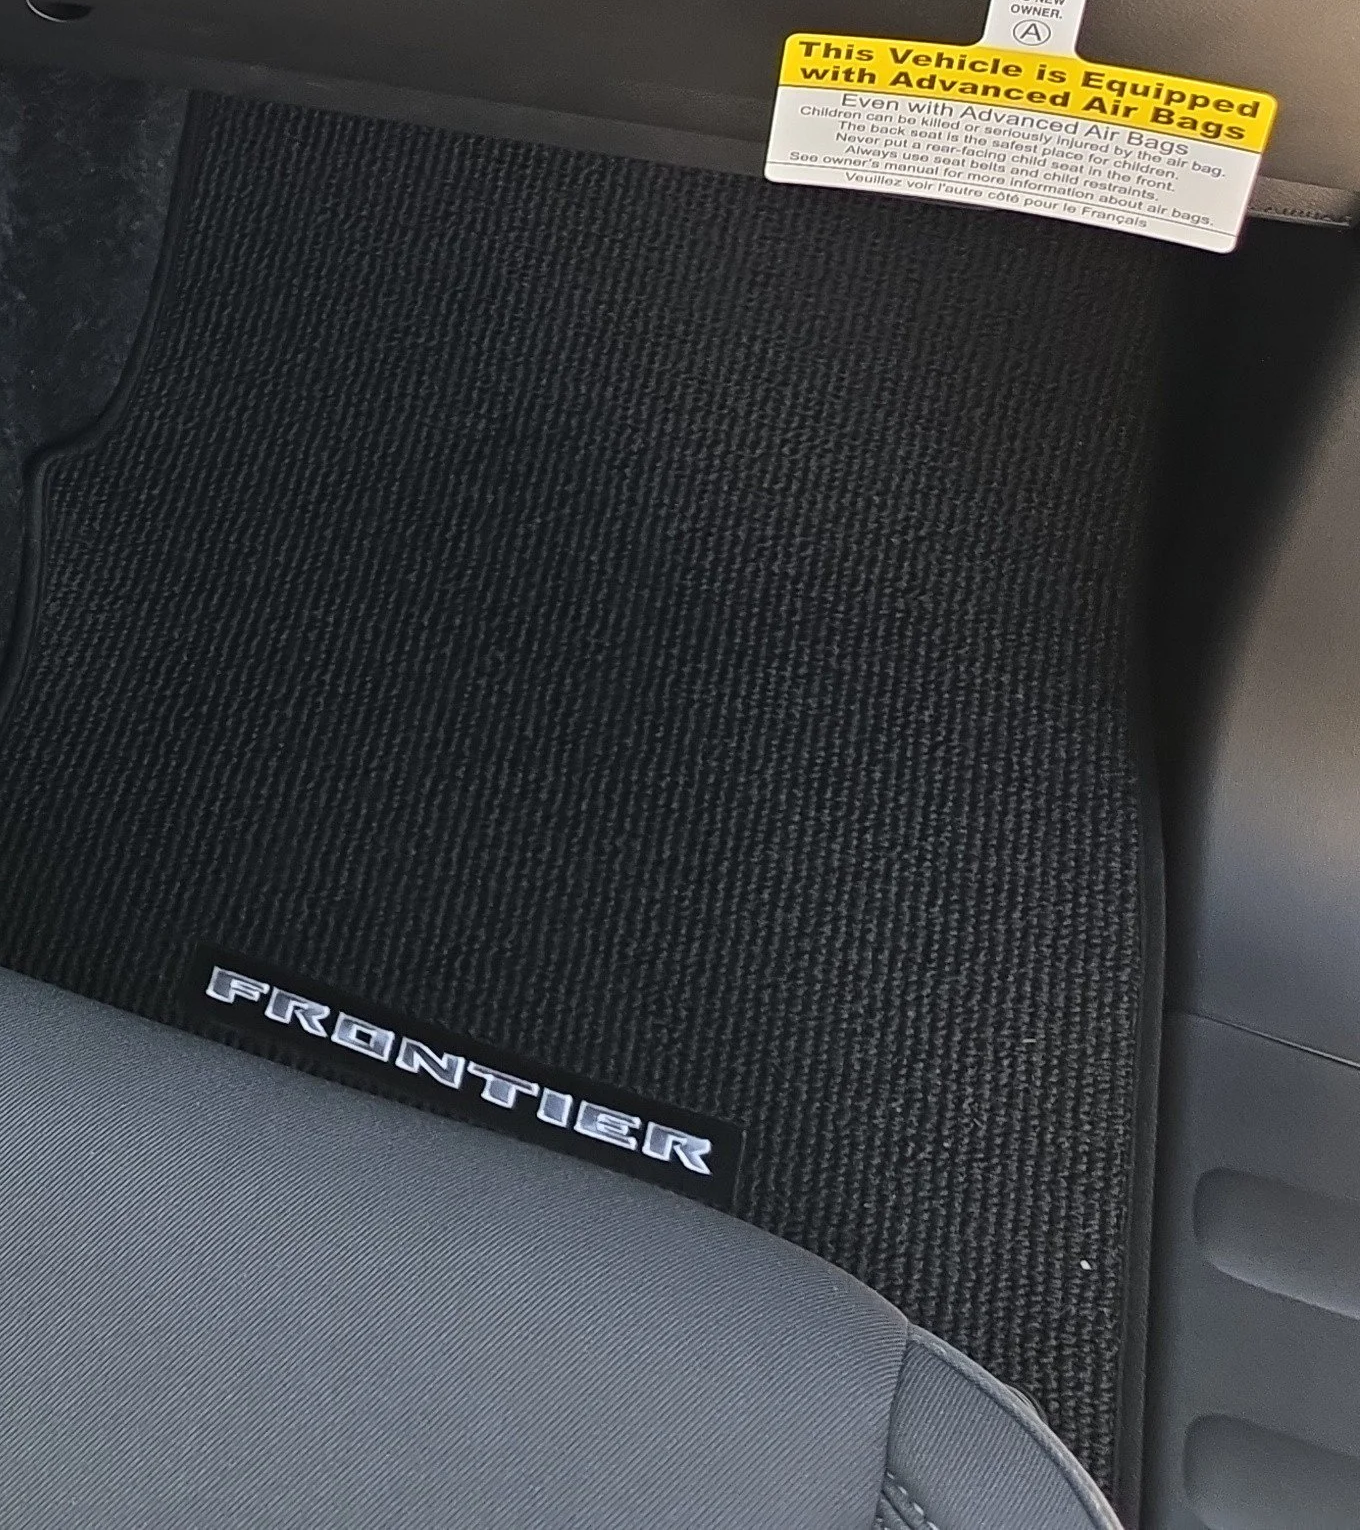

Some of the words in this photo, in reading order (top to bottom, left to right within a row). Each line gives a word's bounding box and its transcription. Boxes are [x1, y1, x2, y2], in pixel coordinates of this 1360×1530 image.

[1010, 3, 1062, 19] OWNER.
[1019, 22, 1041, 41] A
[799, 41, 874, 61] This
[889, 47, 1023, 77] Vehicle
[1036, 64, 1067, 83] is
[1081, 70, 1260, 118] Equipped
[800, 66, 876, 85] with
[889, 71, 1070, 108] Advanced
[1081, 96, 1139, 118] Air
[1150, 106, 1246, 140] Bags
[800, 105, 861, 120] Children
[866, 112, 893, 123] can
[898, 114, 917, 125] be
[921, 116, 961, 131] killed
[964, 123, 980, 133] or
[984, 125, 1052, 145] seriously
[1056, 135, 1111, 155] injured
[1114, 144, 1132, 160] by
[1137, 150, 1162, 164] the
[1167, 154, 1188, 171] air
[1193, 161, 1227, 178] bag.
[838, 120, 865, 132] The
[870, 123, 905, 137] back
[910, 127, 943, 141] seat
[946, 130, 959, 143] is
[963, 132, 987, 146] the
[992, 137, 1038, 154] safest
[1042, 146, 1083, 162] place
[1088, 152, 1109, 166] for
[1113, 157, 1179, 180] children.
[841, 93, 899, 111] Even
[908, 100, 953, 118] with
[960, 105, 1079, 136] Advanced
[1084, 123, 1120, 142] Air
[1127, 131, 1189, 156] Bags
[789, 151, 818, 163] See
[823, 155, 879, 170] owner's
[884, 161, 939, 176] manual
[943, 166, 963, 180] for
[967, 173, 1006, 186] more
[1009, 176, 1094, 201] information
[1099, 192, 1145, 211] about
[1147, 201, 1168, 216] air
[1172, 207, 1214, 227] bags.
[835, 132, 880, 145] Never
[884, 137, 907, 151] put
[911, 141, 921, 150] a
[926, 142, 1006, 163] rear-facing
[1011, 153, 1046, 168] child
[1051, 160, 1084, 174] seat
[1088, 164, 1102, 177] in
[1107, 168, 1130, 183] the
[1136, 174, 1176, 192] front.
[845, 145, 899, 160] Always
[902, 151, 929, 162] use
[934, 154, 966, 168] seat
[970, 158, 1005, 174] belts
[1010, 165, 1039, 179] and
[1043, 170, 1079, 186] child
[1083, 177, 1159, 202] restraints.
[845, 172, 902, 188] Veuillez
[906, 178, 934, 192] voir
[938, 182, 983, 198] l'autre
[988, 188, 1020, 204] côté
[1023, 196, 1063, 211] pour
[1063, 203, 1076, 214] le
[1081, 205, 1147, 229] Français
[205, 965, 713, 1176] FRONTIER
